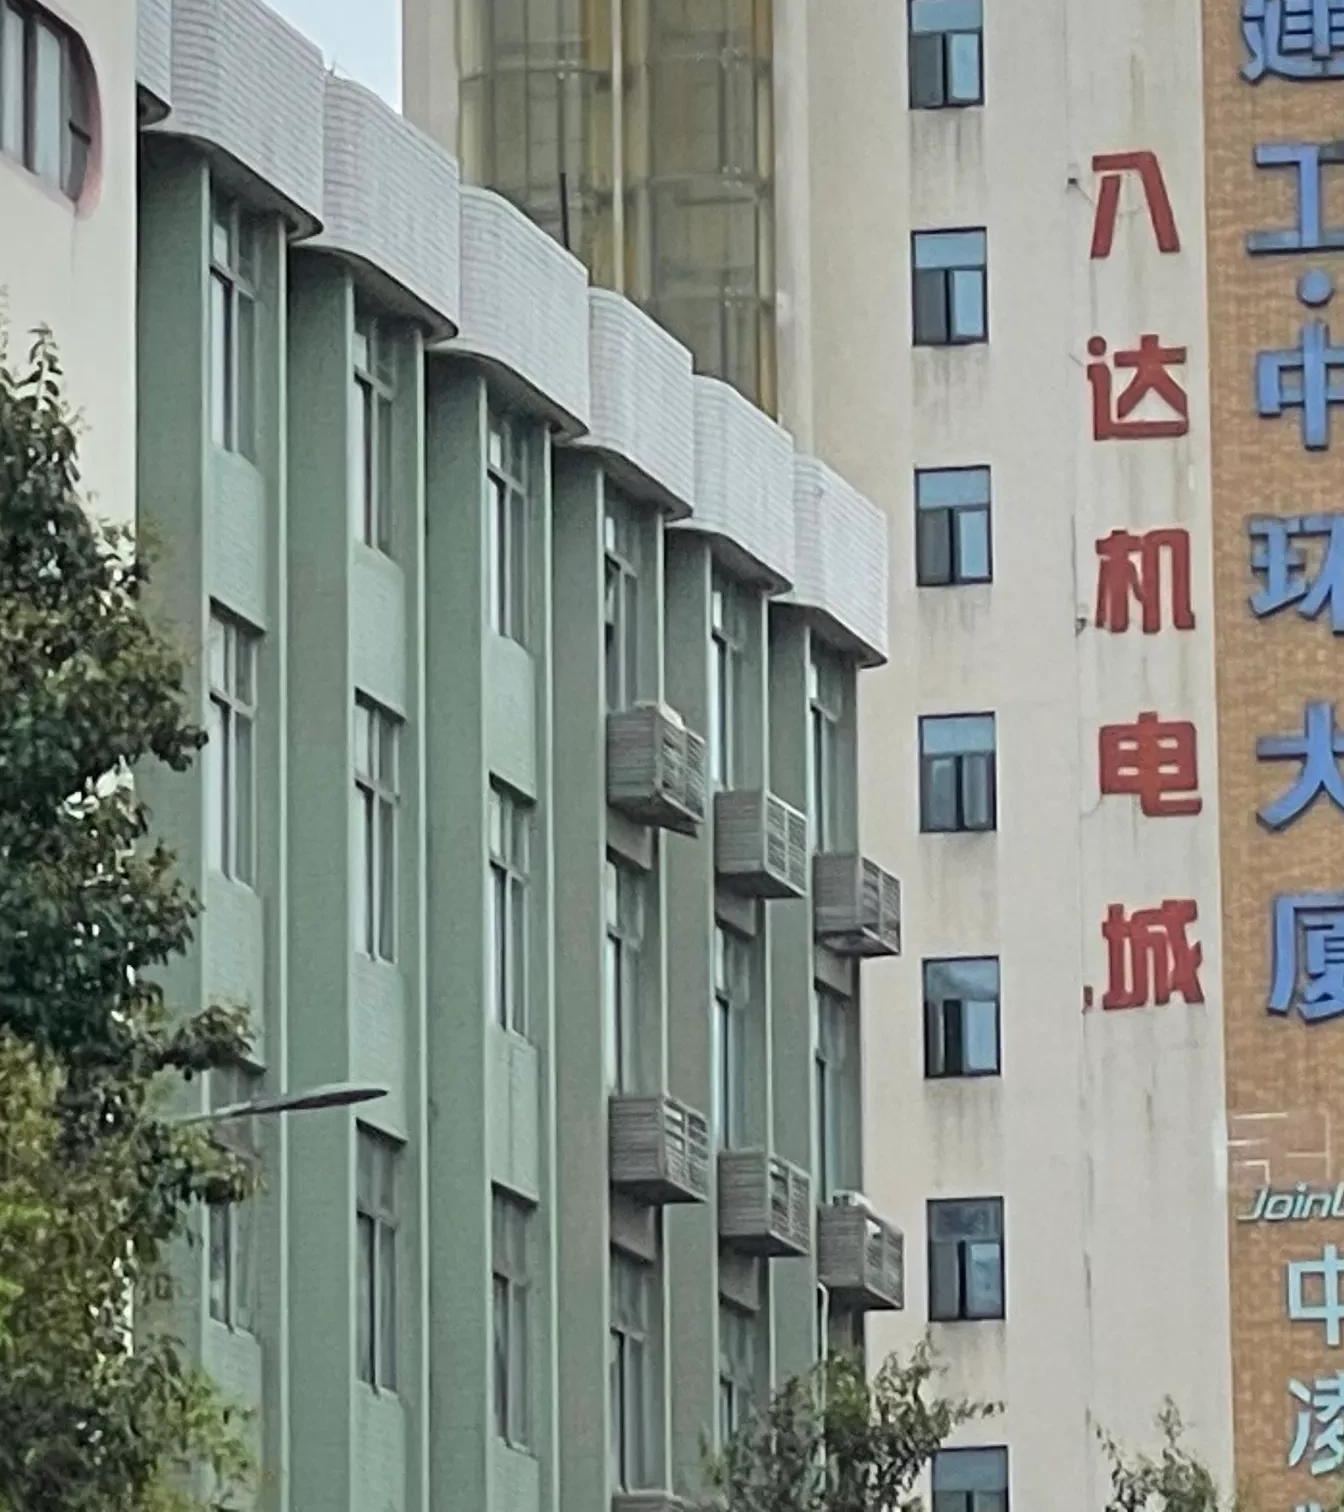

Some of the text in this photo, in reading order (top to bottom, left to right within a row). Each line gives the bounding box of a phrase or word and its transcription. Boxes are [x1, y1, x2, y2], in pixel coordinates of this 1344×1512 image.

[1085, 150, 1206, 1012] 八达机电城
